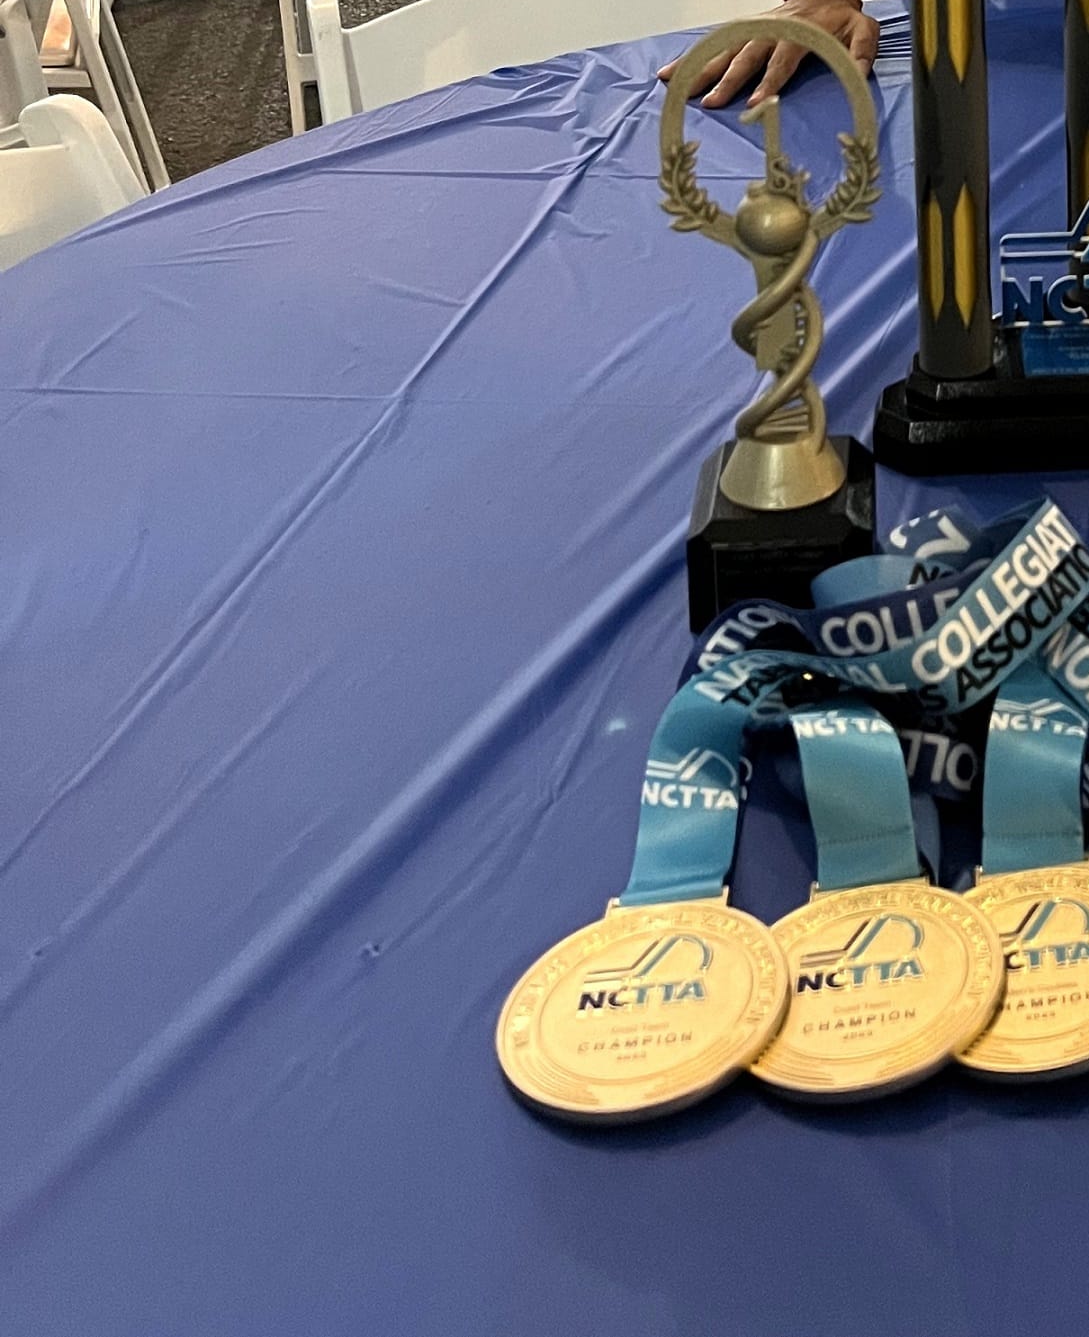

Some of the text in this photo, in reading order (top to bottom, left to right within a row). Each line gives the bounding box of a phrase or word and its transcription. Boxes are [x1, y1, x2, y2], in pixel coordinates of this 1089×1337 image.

[792, 713, 896, 738] NCTTA
[641, 784, 739, 810] NCTTA
[797, 958, 923, 993] NCTTA
[577, 979, 706, 1012] NCTTA
[802, 1007, 916, 1034] CHAMPION
[577, 1030, 693, 1054] CHAMPION
